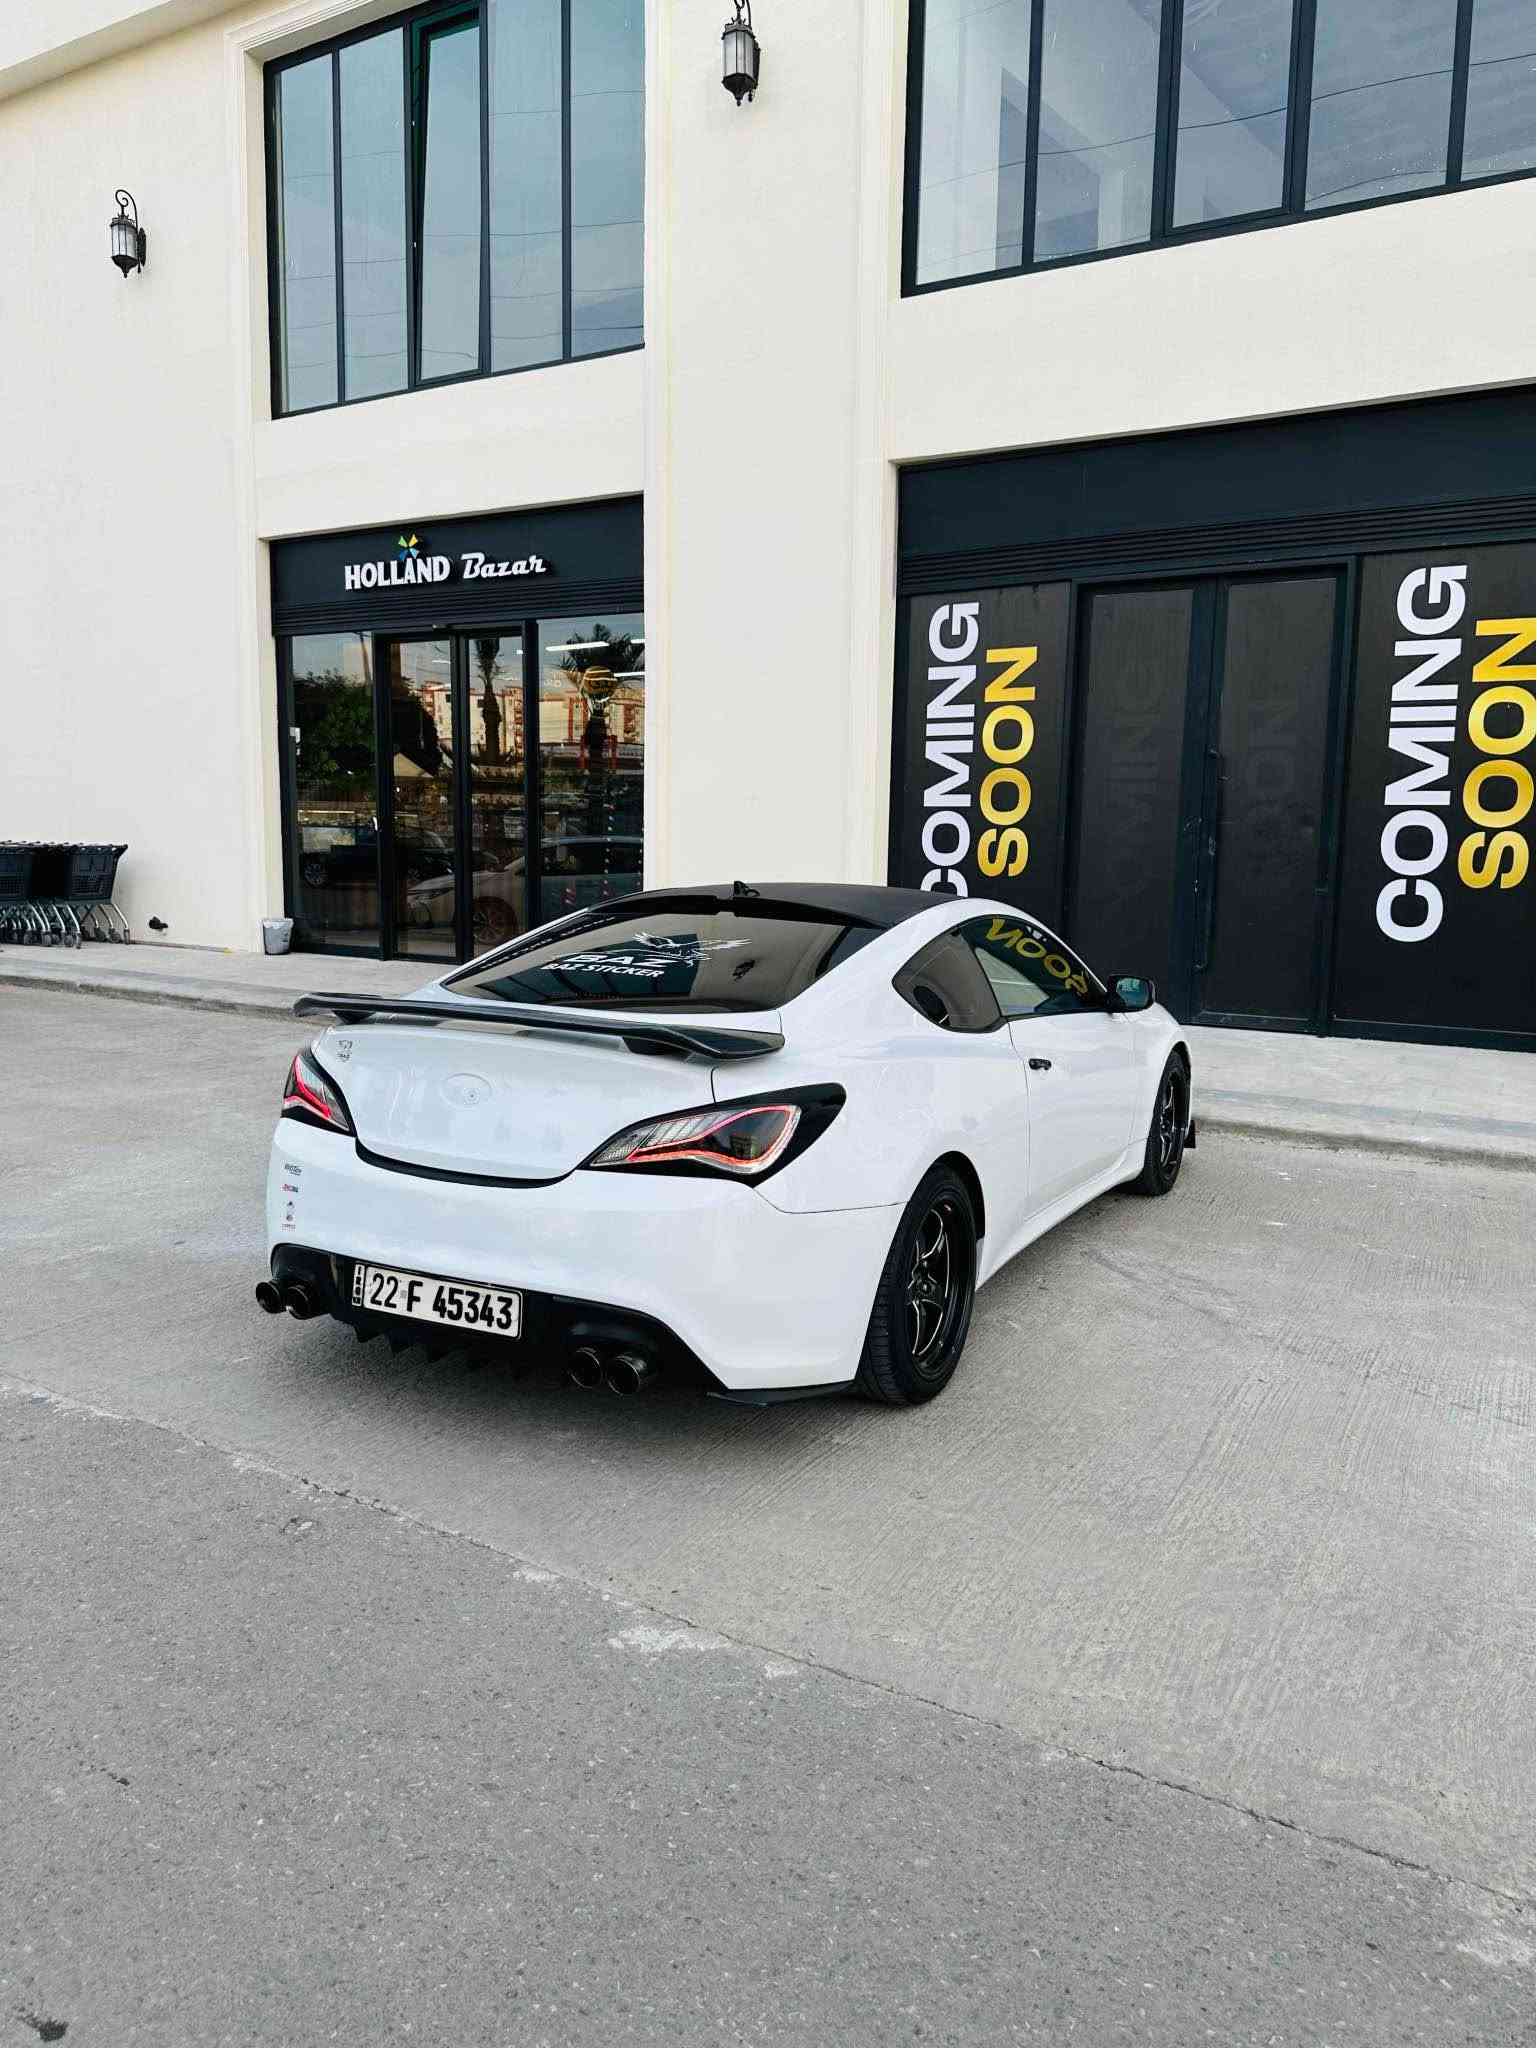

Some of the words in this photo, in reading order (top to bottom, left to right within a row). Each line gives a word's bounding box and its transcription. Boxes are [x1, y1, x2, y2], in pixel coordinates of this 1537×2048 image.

[344, 556, 451, 590] HOLLAND
[461, 552, 547, 579] Bazar
[977, 646, 1038, 877] SOON
[1376, 564, 1468, 943] COMING
[1458, 617, 1536, 889] SOON
[578, 964, 665, 978] STICKER
[370, 1272, 399, 1309] 22
[406, 1279, 423, 1312] F
[432, 1285, 513, 1330] 45343
